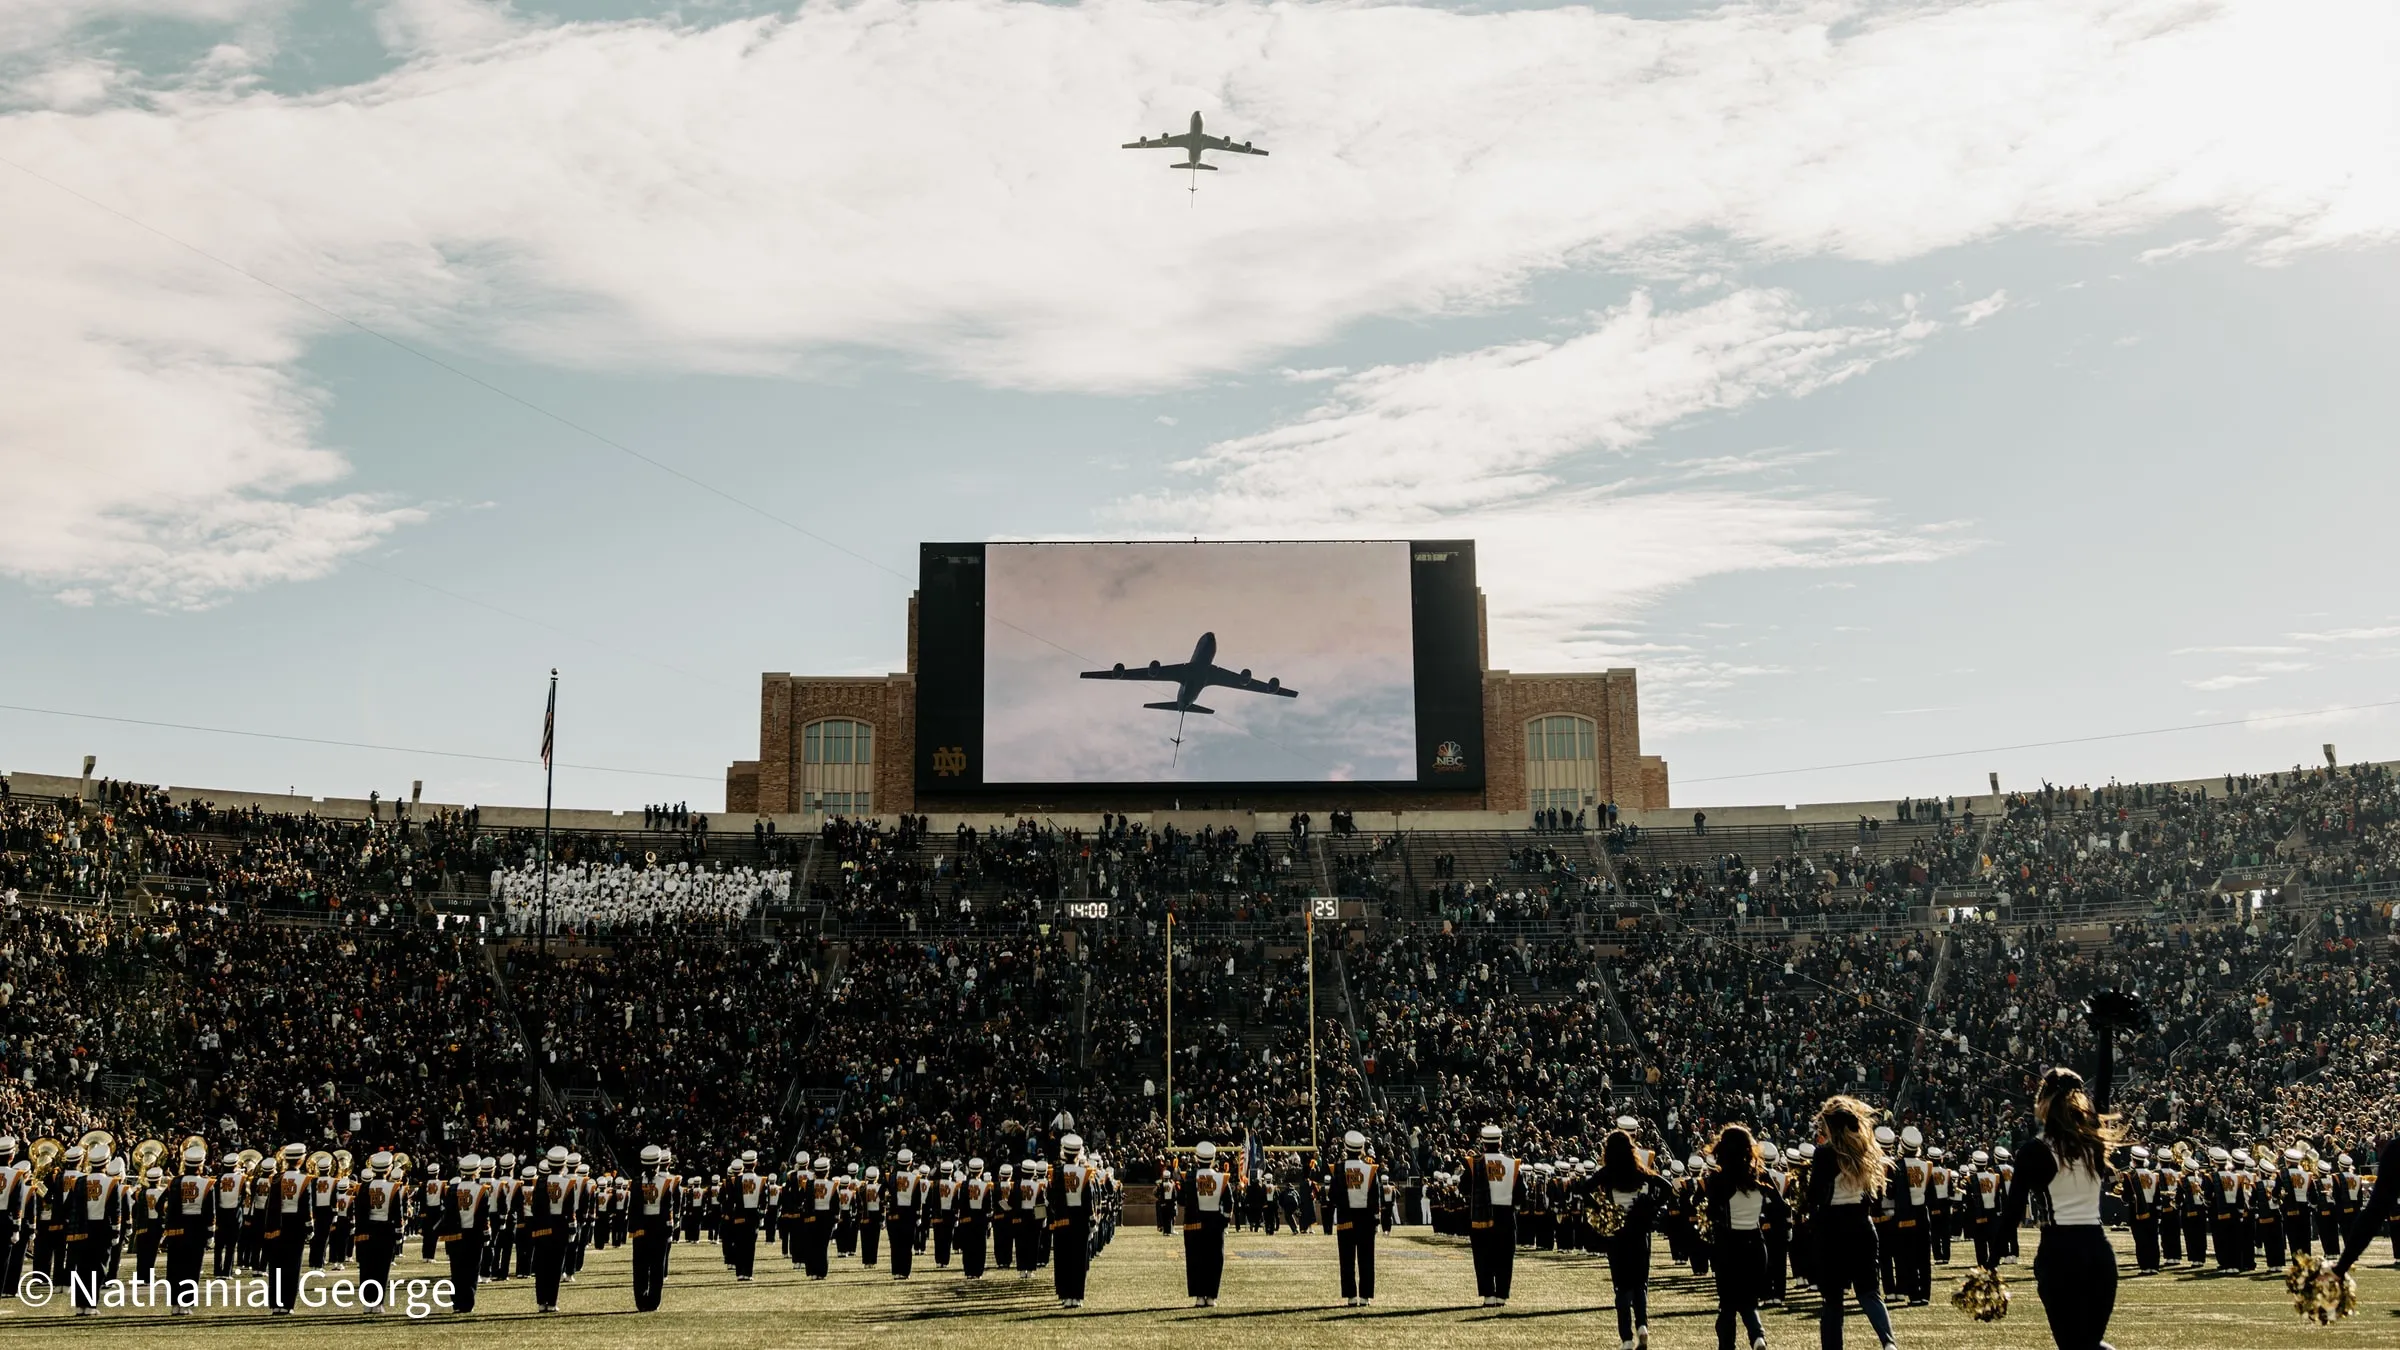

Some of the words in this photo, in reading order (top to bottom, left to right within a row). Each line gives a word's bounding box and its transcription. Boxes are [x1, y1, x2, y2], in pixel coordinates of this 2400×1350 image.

[1436, 756, 1463, 766] NBC
[1070, 902, 1108, 919] 14:00
[1315, 900, 1335, 916] 25
[1197, 1174, 1217, 1196] ND
[1346, 1168, 1364, 1189] ND
